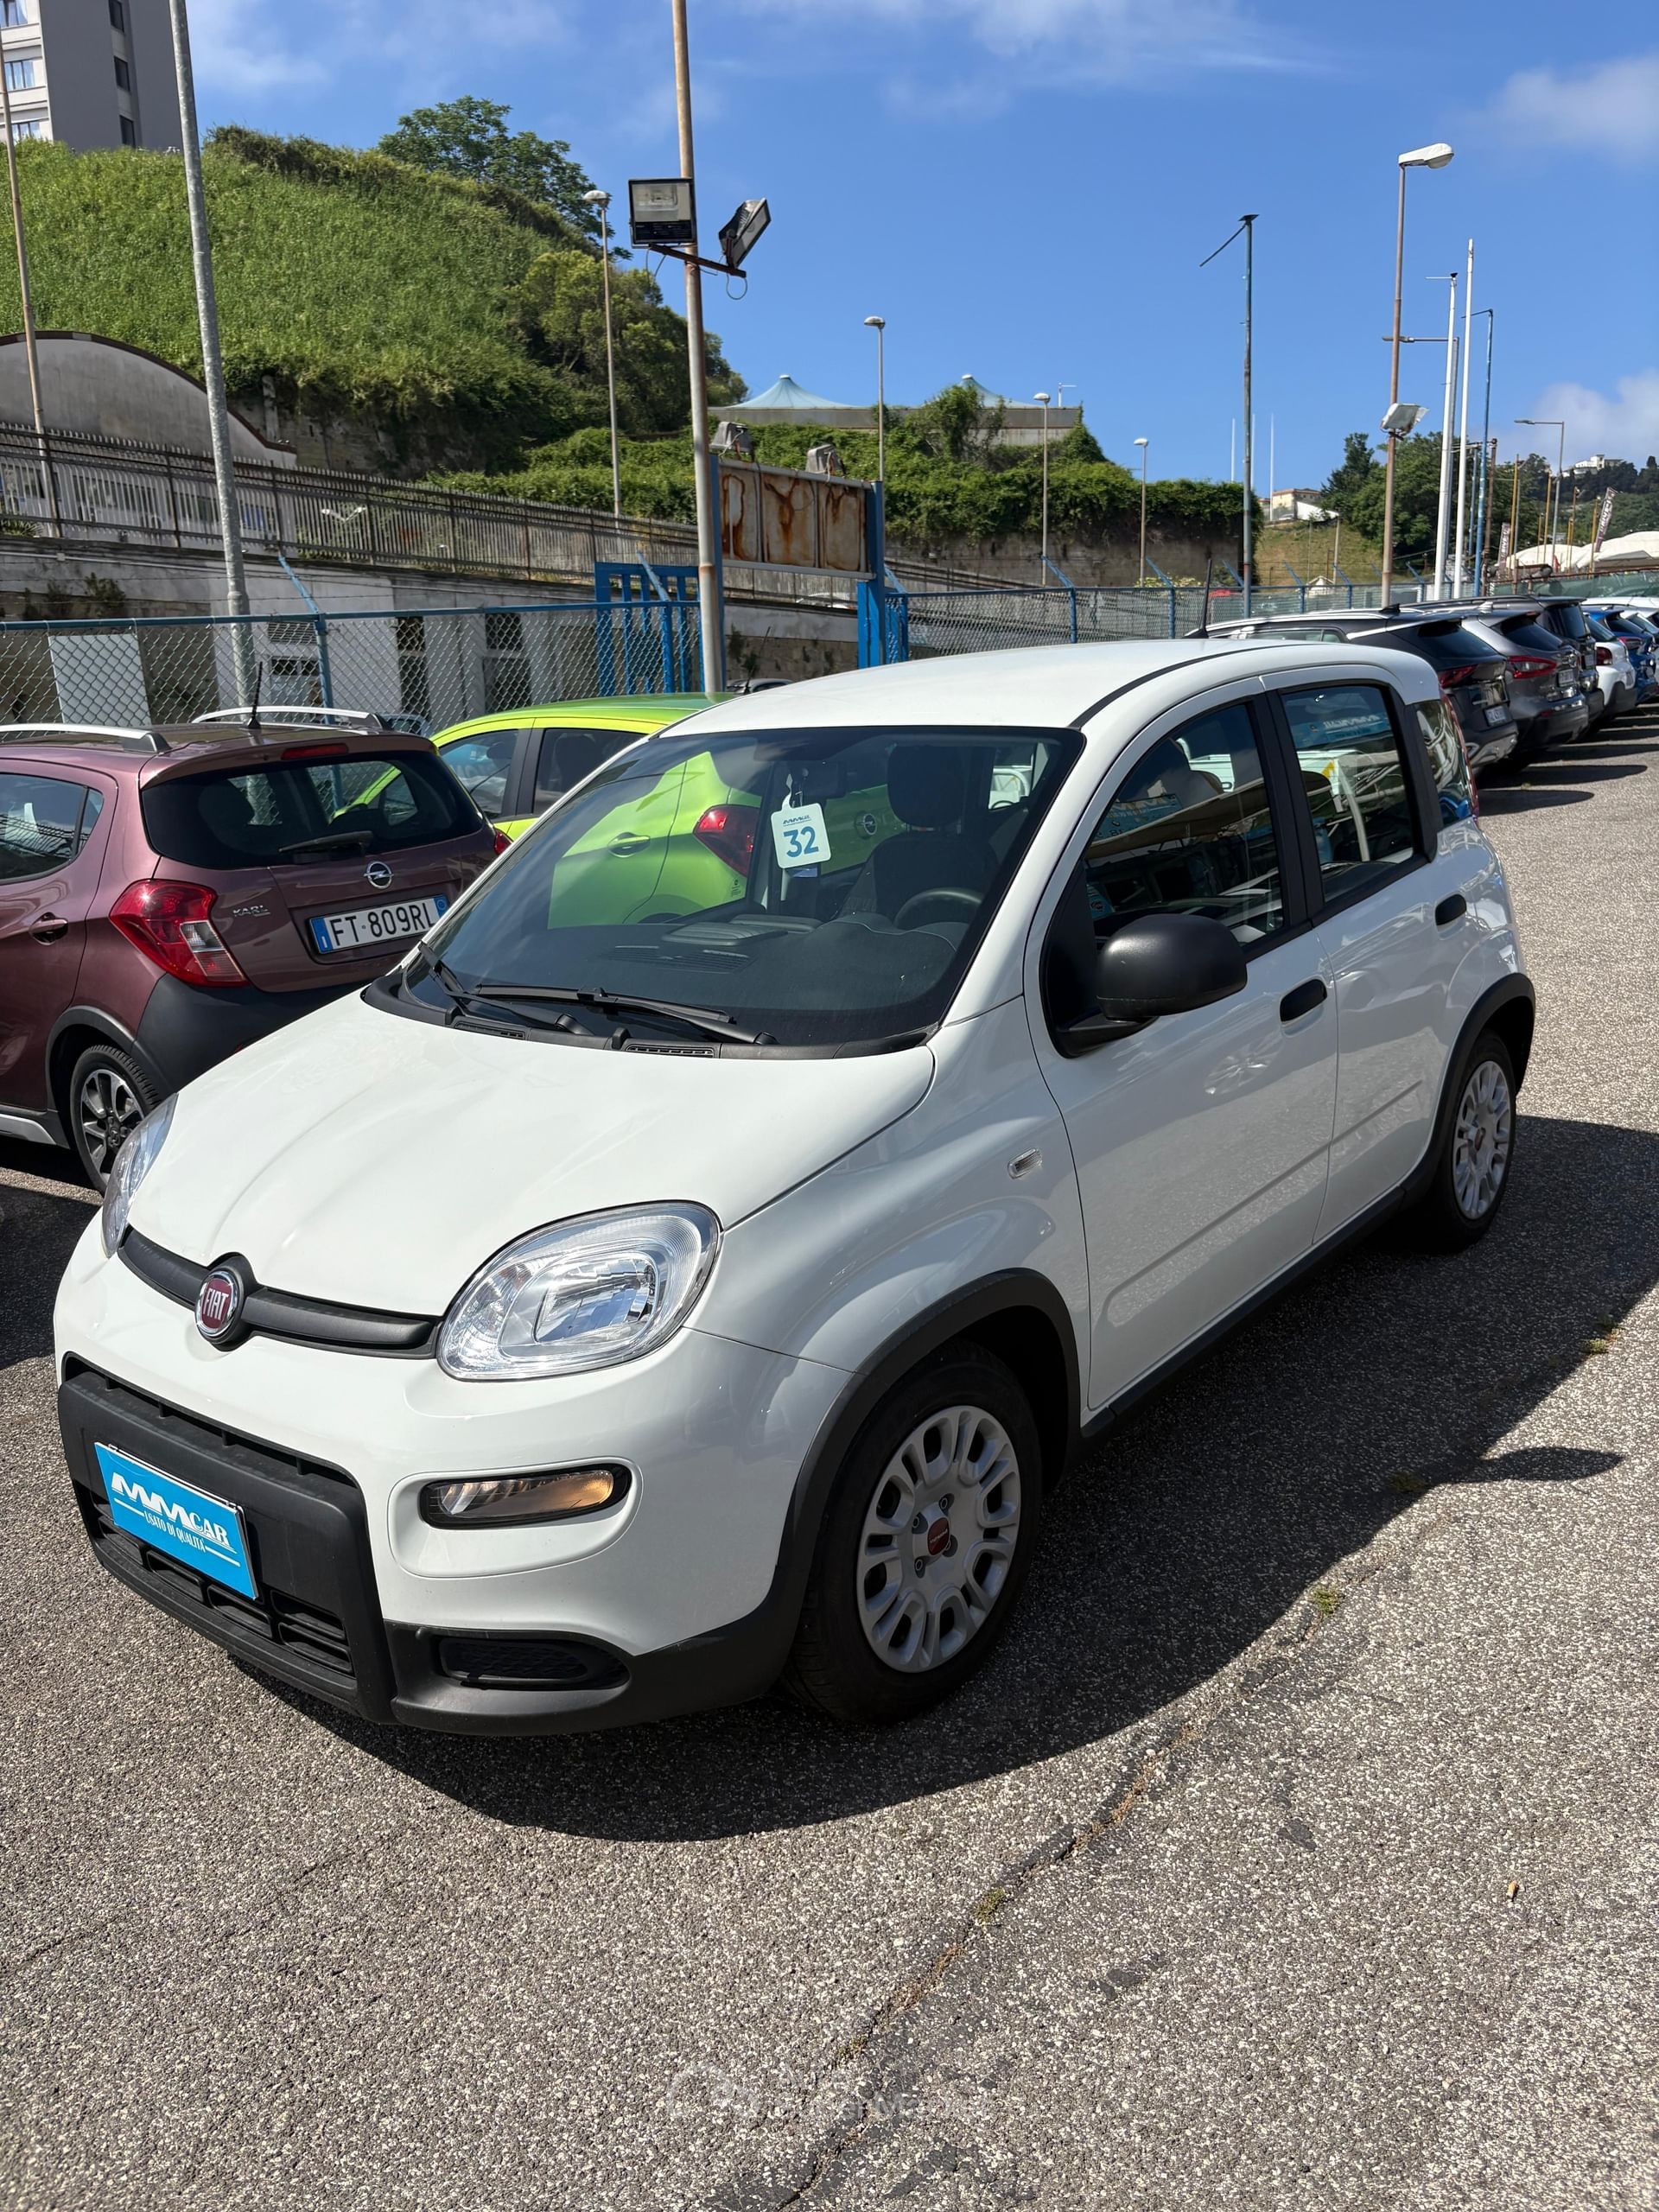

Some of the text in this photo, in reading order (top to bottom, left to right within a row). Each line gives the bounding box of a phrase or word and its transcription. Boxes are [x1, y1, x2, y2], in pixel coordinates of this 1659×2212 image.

[783, 826, 819, 857] 32
[329, 902, 435, 946] FT 809RL
[202, 1287, 230, 1321] FIAT
[143, 1510, 167, 1533] USATO
[166, 1522, 176, 1537] DI
